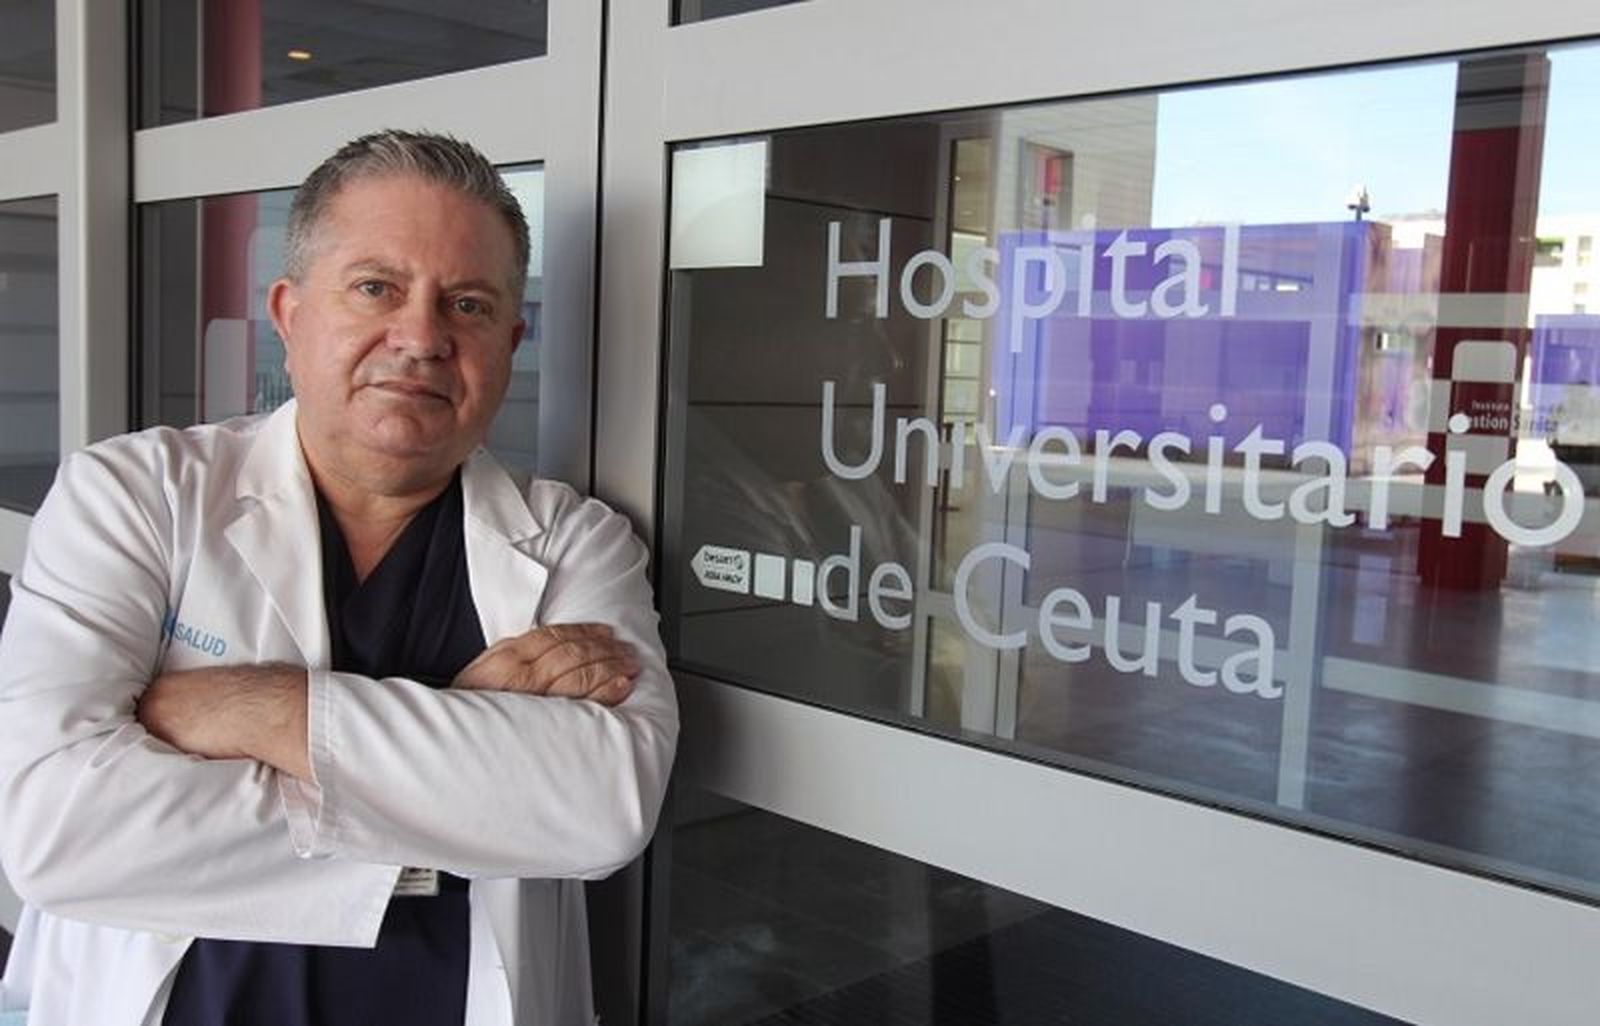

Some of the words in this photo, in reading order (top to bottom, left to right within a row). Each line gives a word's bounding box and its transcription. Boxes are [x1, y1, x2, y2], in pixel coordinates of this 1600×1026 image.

[824, 213, 1239, 353] Hospital
[821, 380, 1586, 547] Universitario
[168, 614, 226, 656] SALUD
[816, 525, 913, 630] de
[953, 542, 1283, 699] Ceuta
